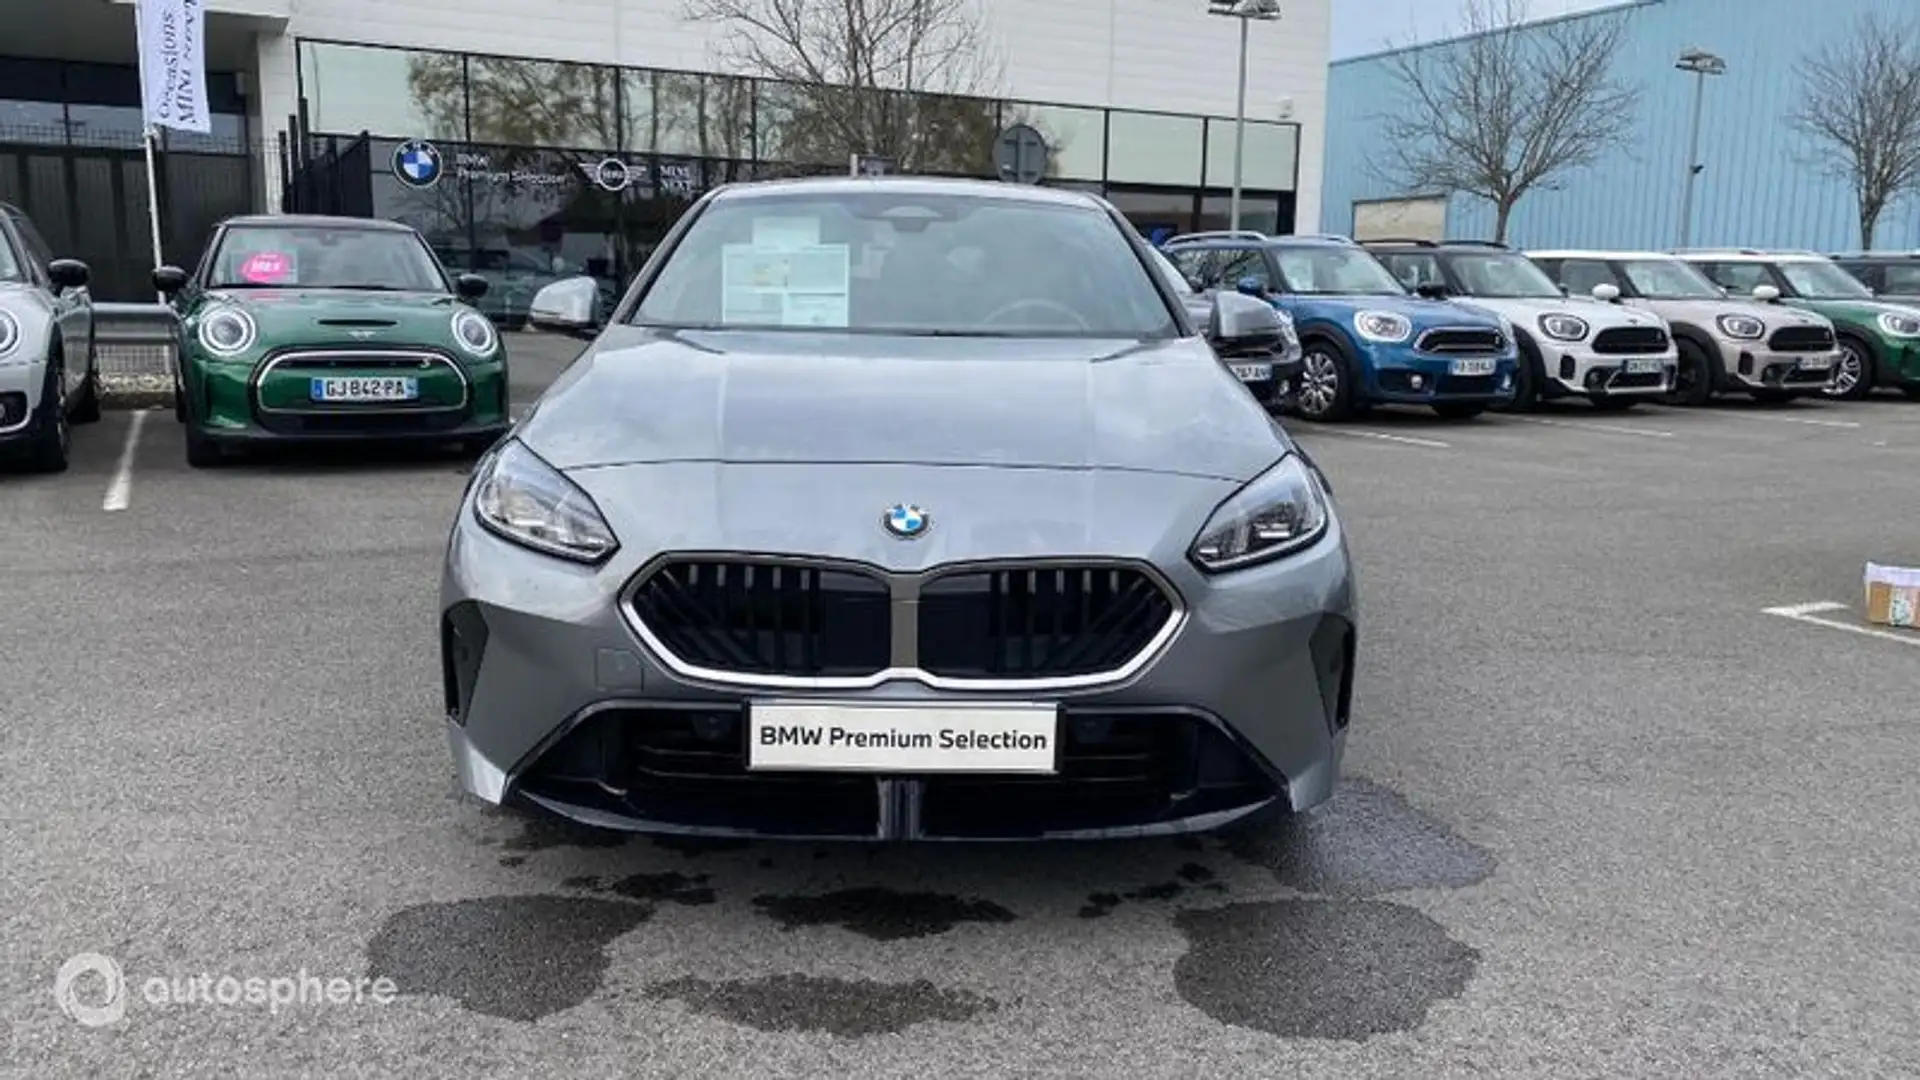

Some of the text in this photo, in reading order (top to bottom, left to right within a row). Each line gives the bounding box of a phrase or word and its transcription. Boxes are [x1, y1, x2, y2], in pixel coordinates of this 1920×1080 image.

[158, 9, 179, 119] Occasions
[760, 725, 1047, 750] BMW Premium Selection
